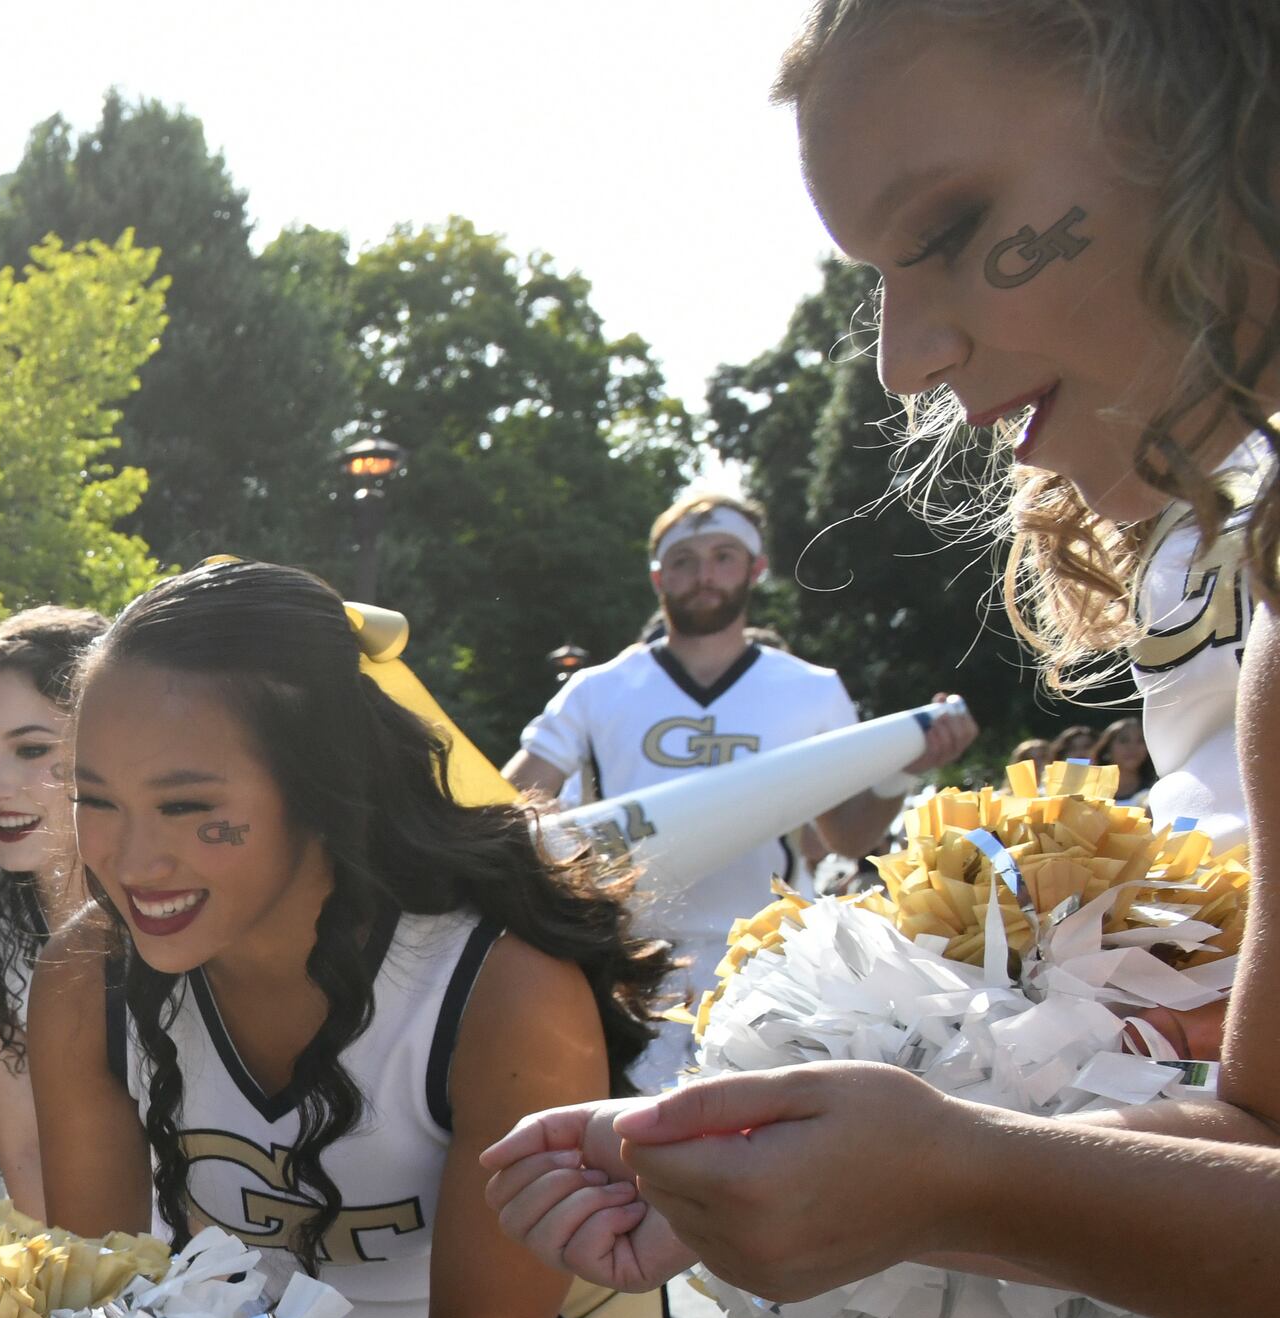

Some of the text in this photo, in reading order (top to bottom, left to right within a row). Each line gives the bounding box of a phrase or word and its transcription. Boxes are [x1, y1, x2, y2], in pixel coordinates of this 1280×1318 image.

[983, 205, 1094, 290] GT
[643, 714, 762, 769] GT
[196, 820, 251, 847] GT
[176, 1128, 426, 1266] GT
